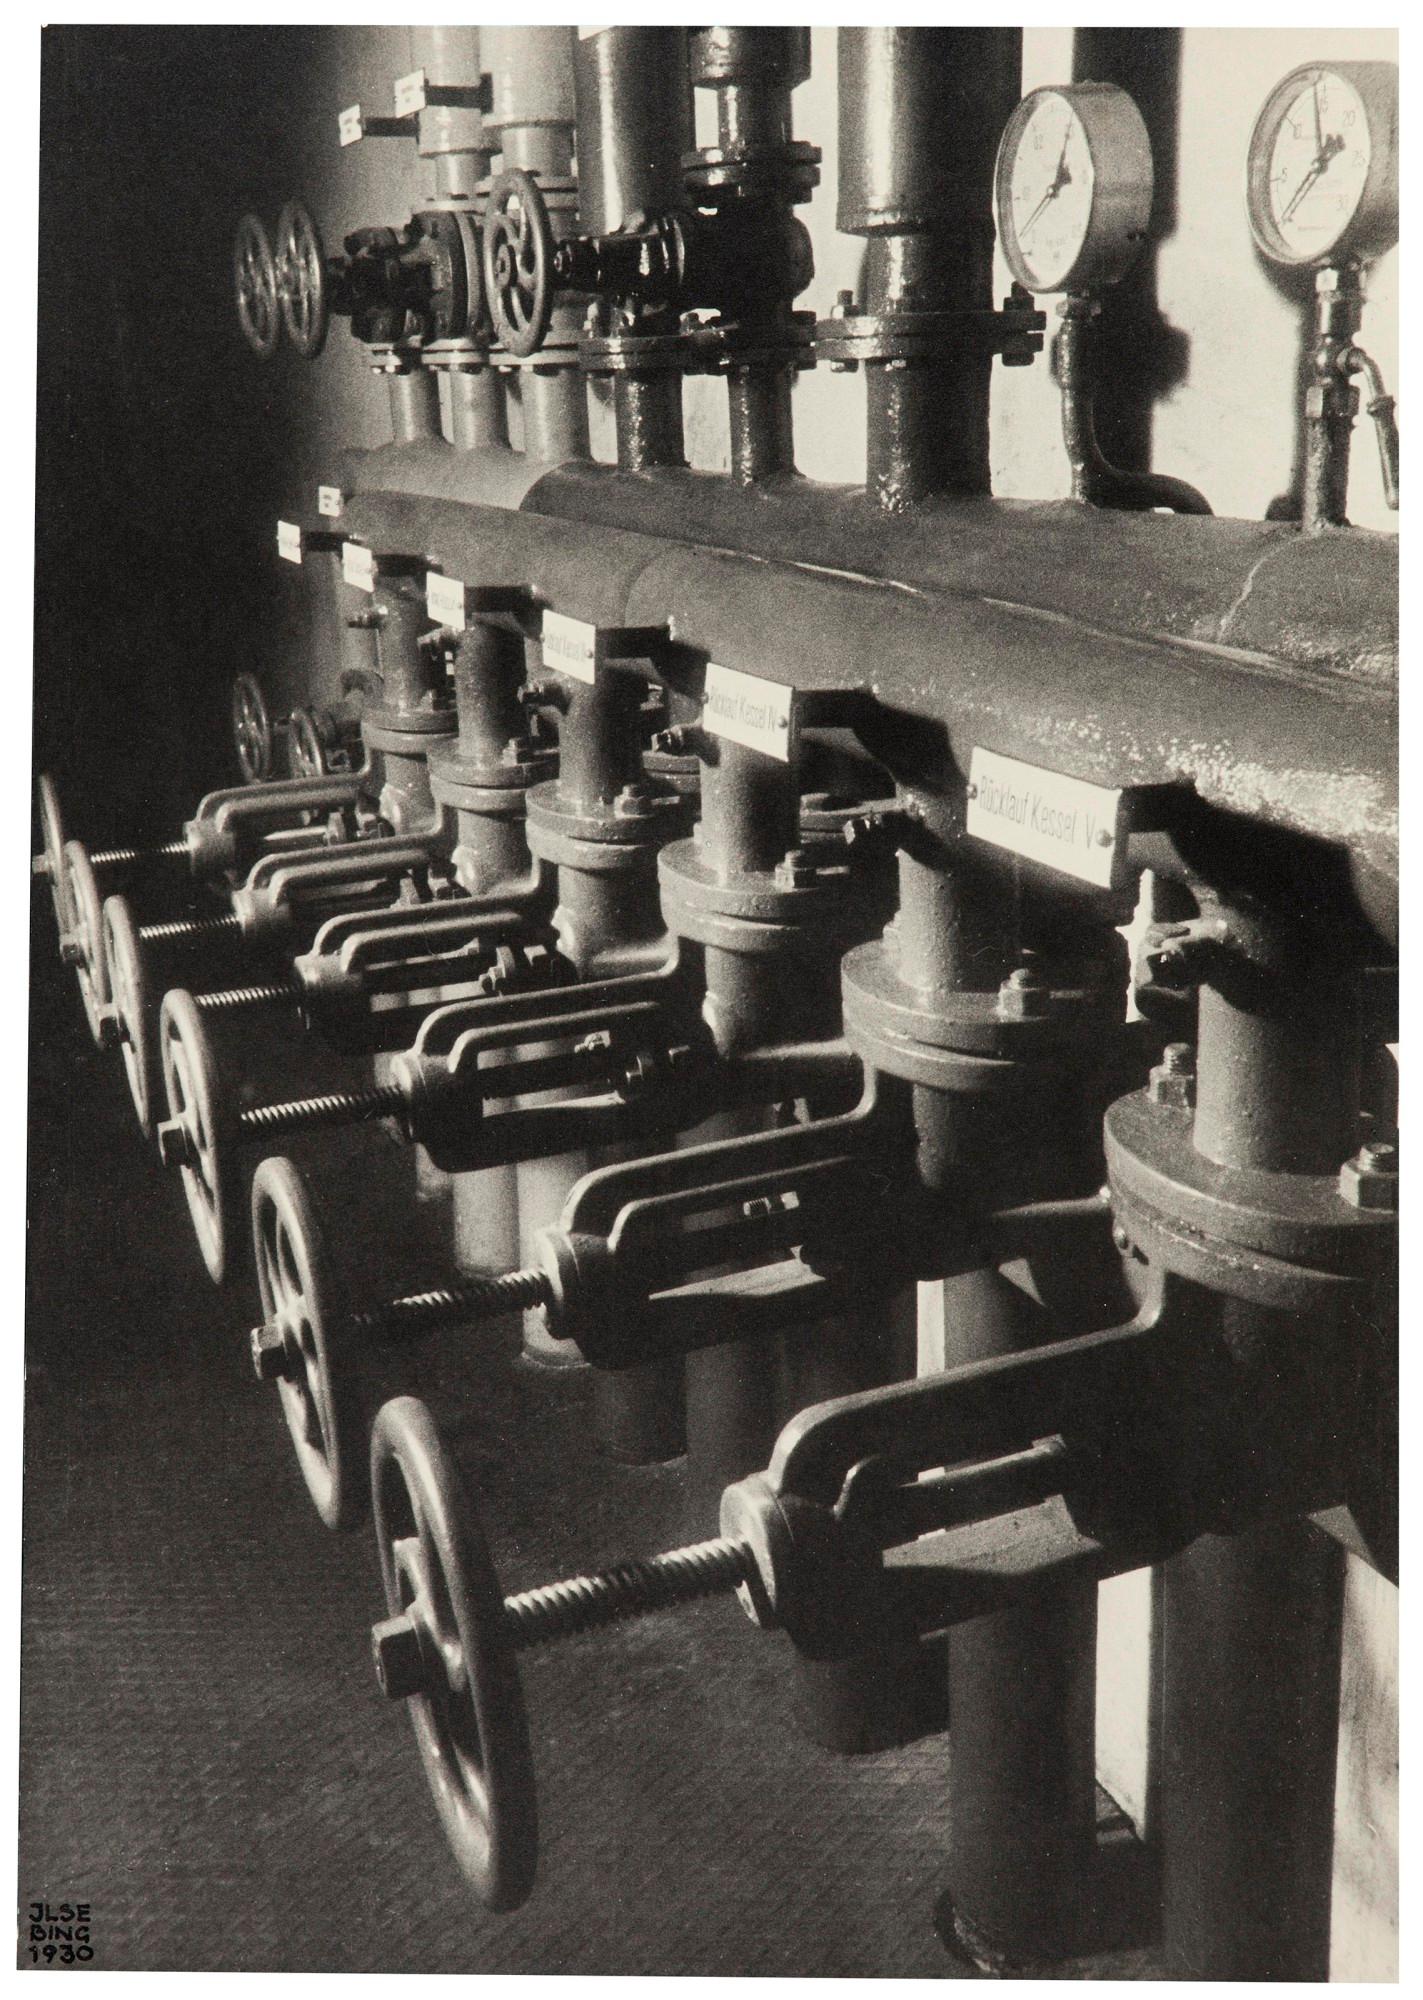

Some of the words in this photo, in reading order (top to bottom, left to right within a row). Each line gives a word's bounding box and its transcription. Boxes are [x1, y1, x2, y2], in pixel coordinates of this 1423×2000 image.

[979, 775, 1029, 824] Rücklauf
[1031, 793, 1077, 844] Kessel
[1085, 813, 1096, 849] V
[30, 1924, 89, 1943] BING
[29, 1944, 94, 1964] 1930
